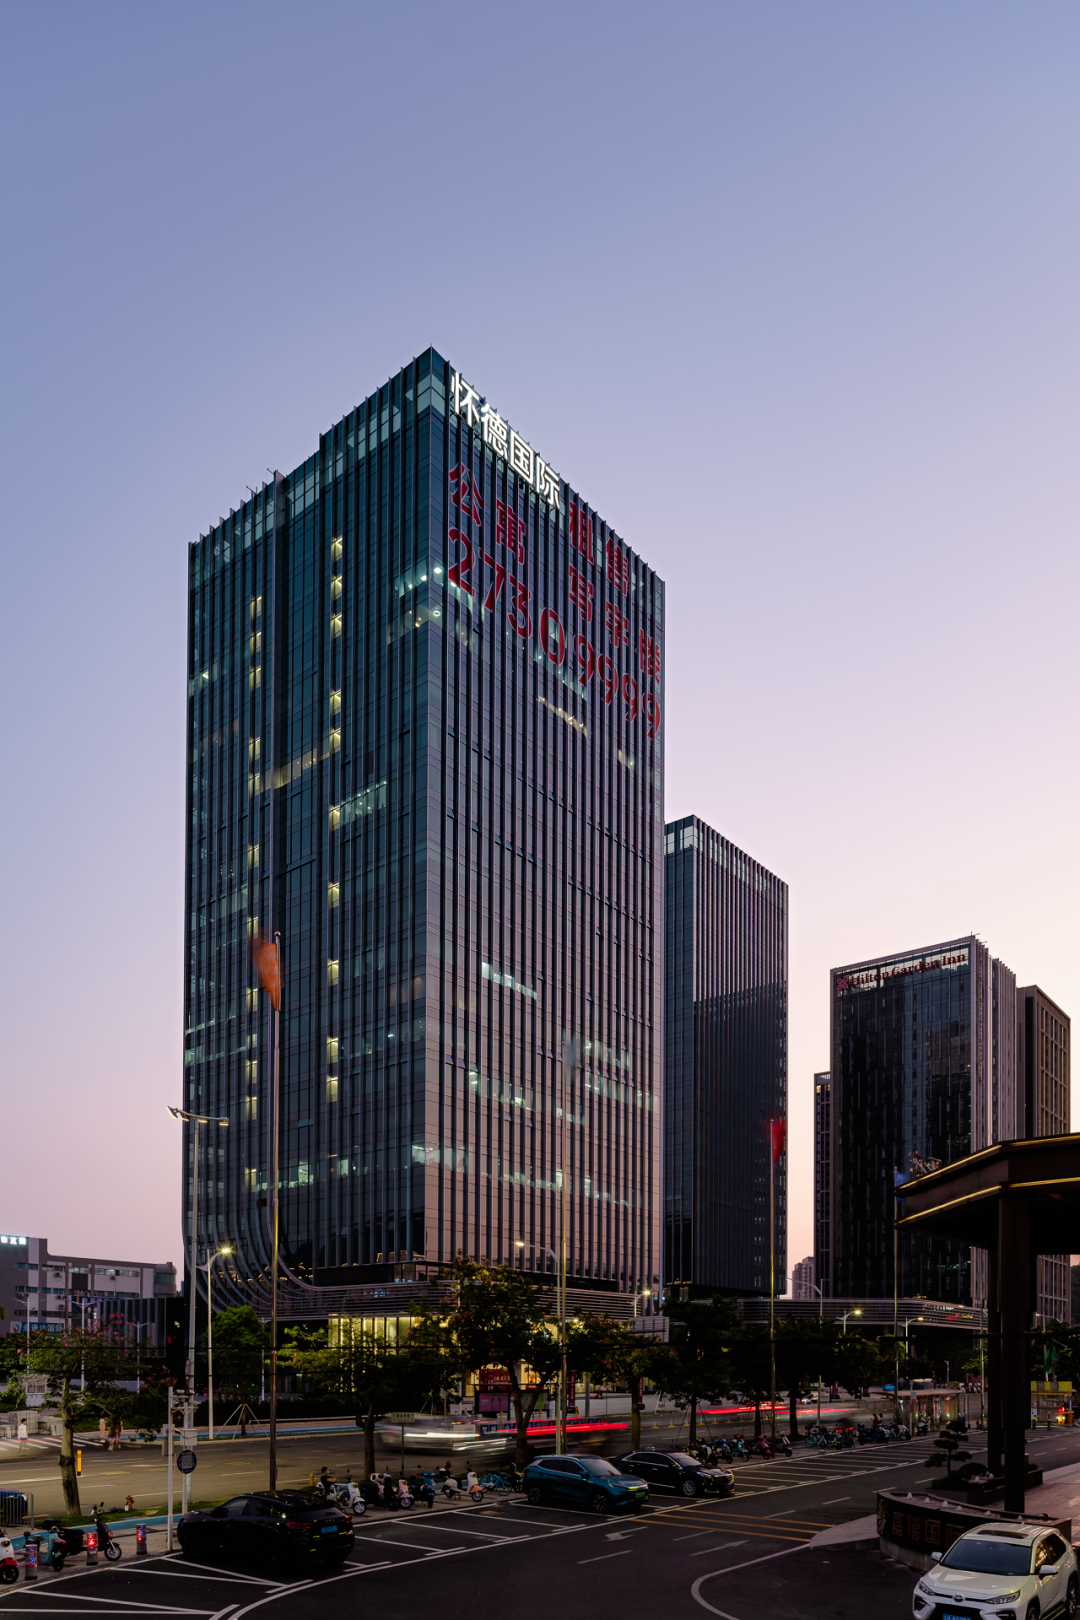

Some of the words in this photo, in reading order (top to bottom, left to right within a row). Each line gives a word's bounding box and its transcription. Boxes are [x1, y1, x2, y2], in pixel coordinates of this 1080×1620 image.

[451, 372, 560, 509] 怀德国际
[449, 462, 526, 566] 公寓
[568, 564, 661, 684] 写字楼
[568, 500, 628, 597] 租售
[448, 526, 661, 739] 27309999
[851, 971, 889, 987] Hilton
[891, 959, 939, 977] Garden
[942, 953, 966, 966] Inn
